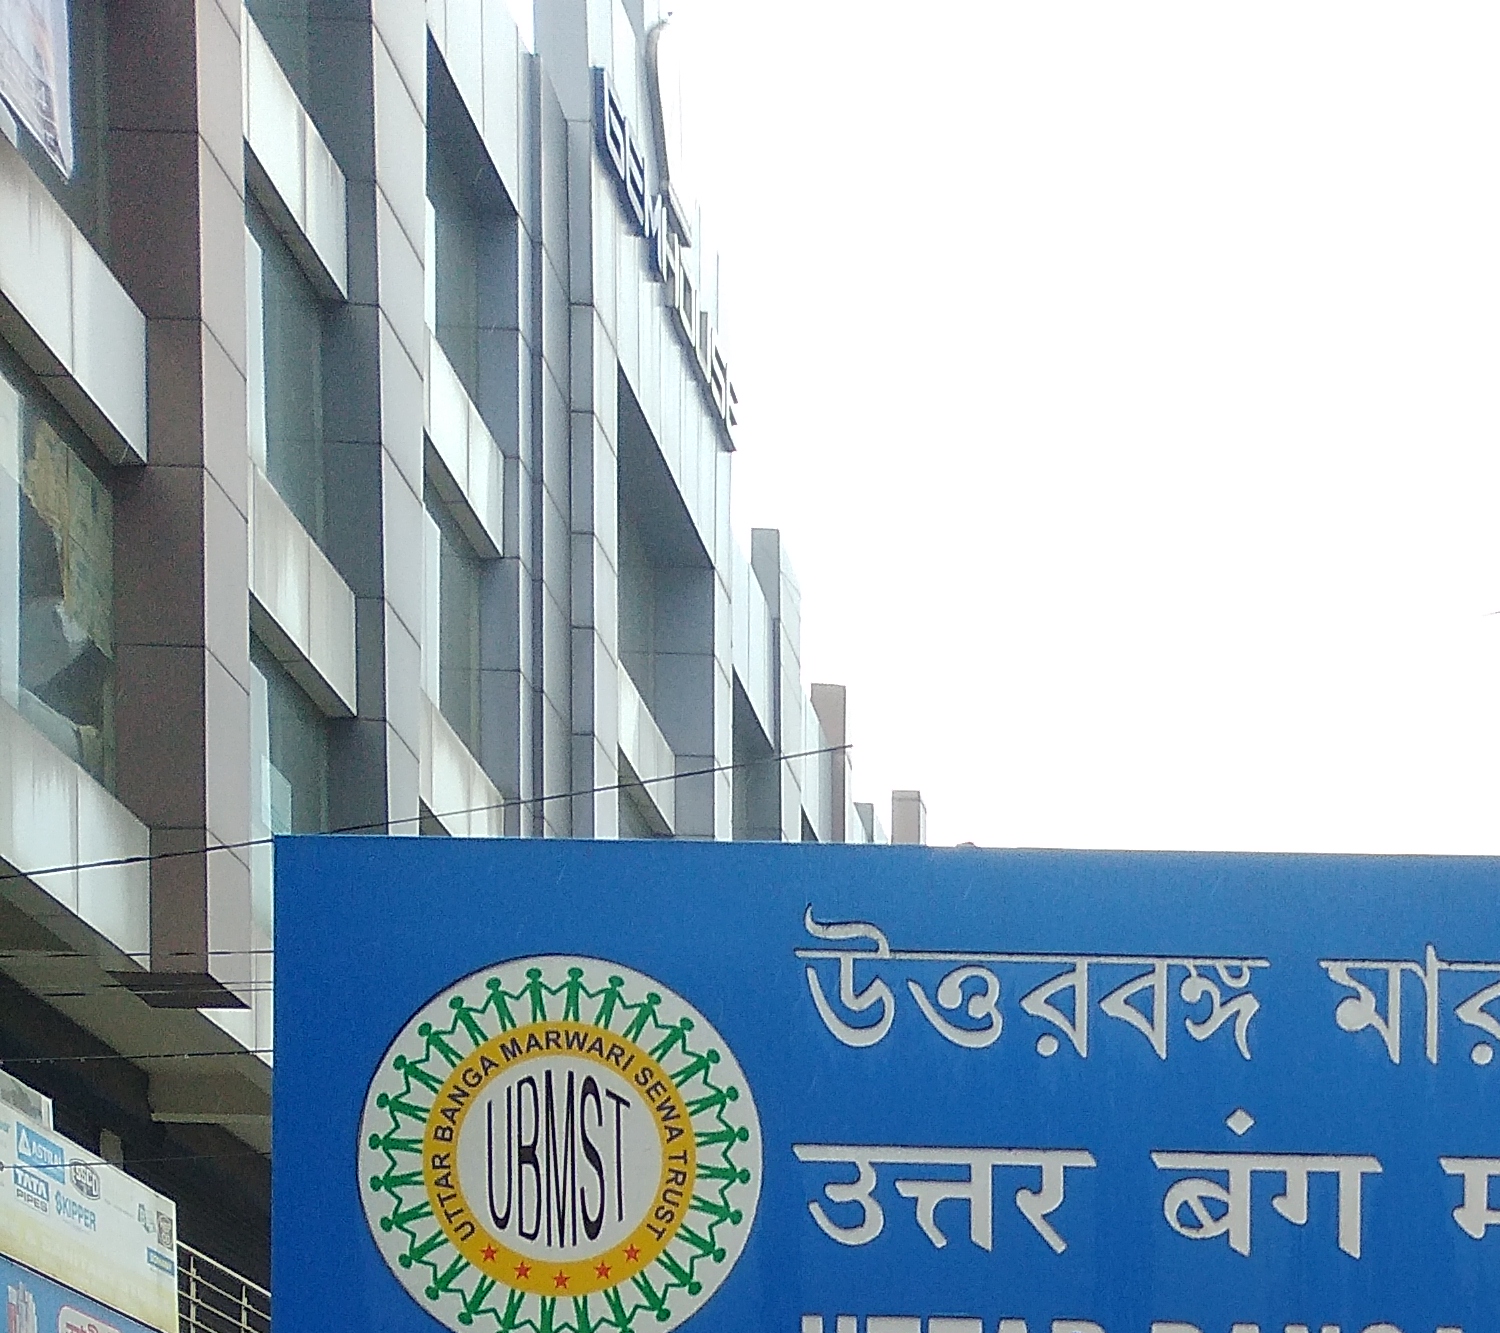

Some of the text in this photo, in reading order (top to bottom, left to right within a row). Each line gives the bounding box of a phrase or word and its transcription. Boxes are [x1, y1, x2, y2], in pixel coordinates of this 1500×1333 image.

[794, 904, 1270, 1060] উত্তরবঙ্গ
[15, 1169, 47, 1200] TATA
[16, 1189, 48, 1213] PIPES
[55, 1190, 96, 1231] SKIPPER
[432, 1029, 688, 1243] UTTAR BANGA MARWARI SEWA TRUST
[487, 1069, 631, 1249] UBMST
[792, 1144, 1096, 1255] उत्तर
[1151, 1108, 1382, 1258] बंग
